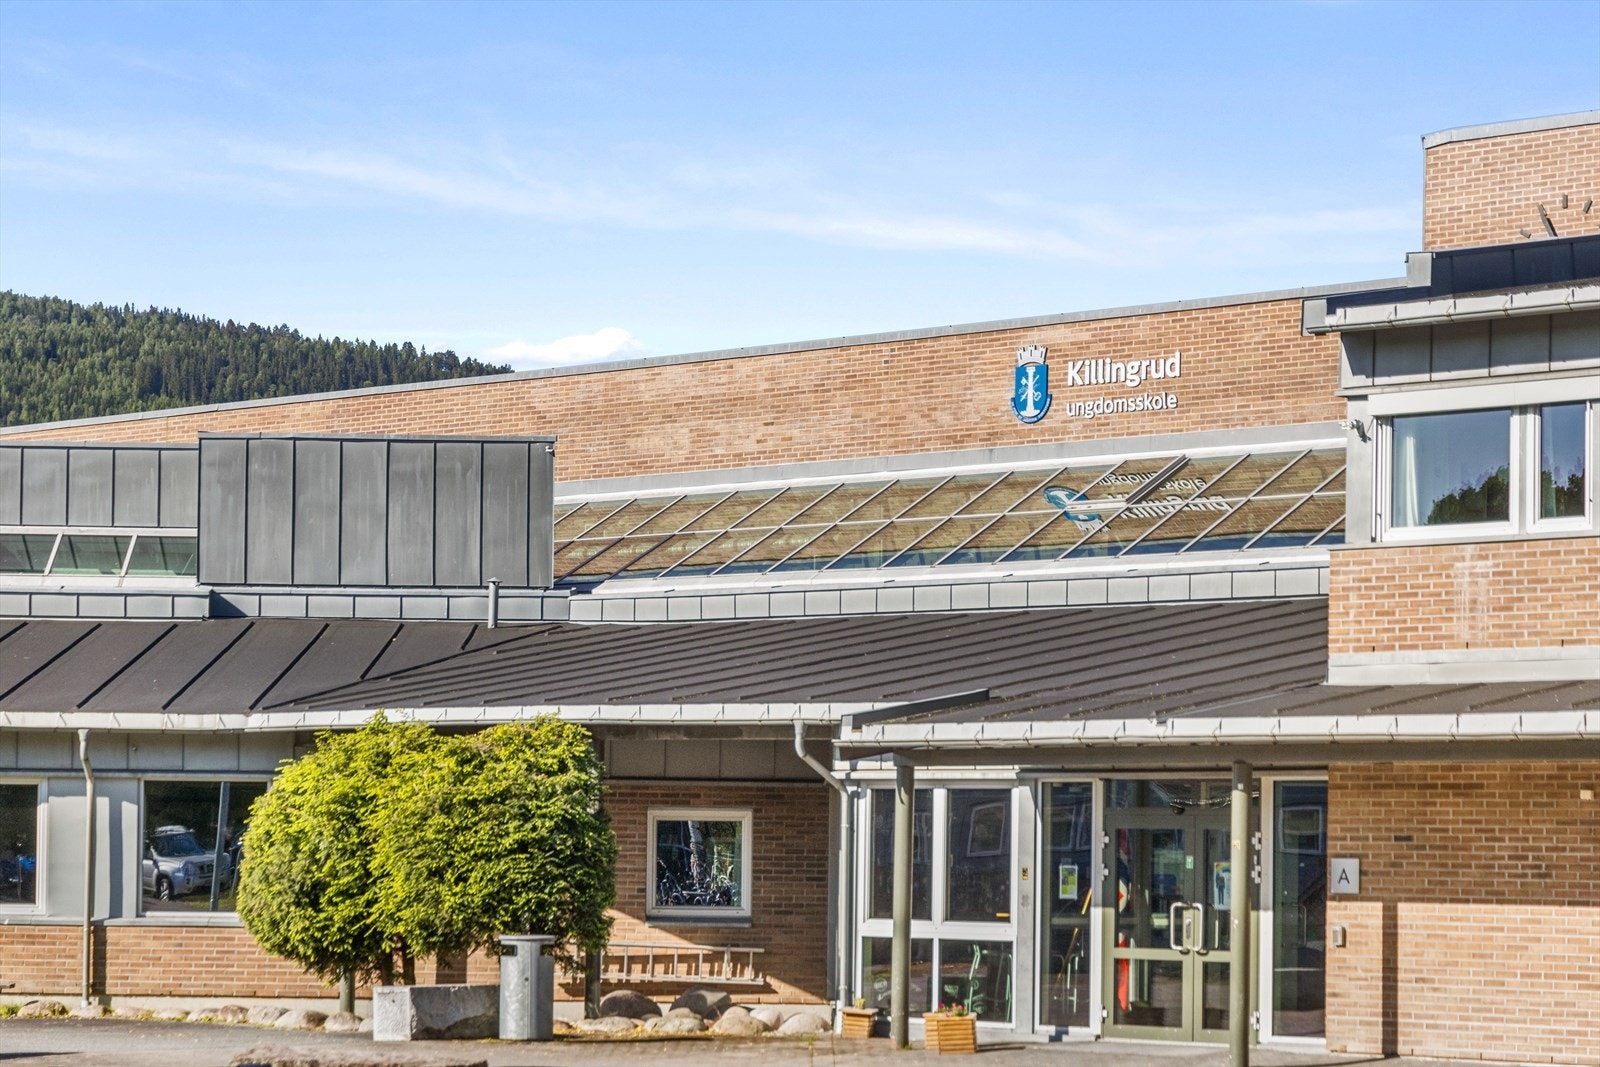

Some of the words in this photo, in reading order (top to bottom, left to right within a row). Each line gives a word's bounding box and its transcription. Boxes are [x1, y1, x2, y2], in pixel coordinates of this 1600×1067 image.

[1067, 351, 1181, 387] Killingrud
[1066, 391, 1178, 419] ungdomsskole
[1337, 867, 1351, 885] A
